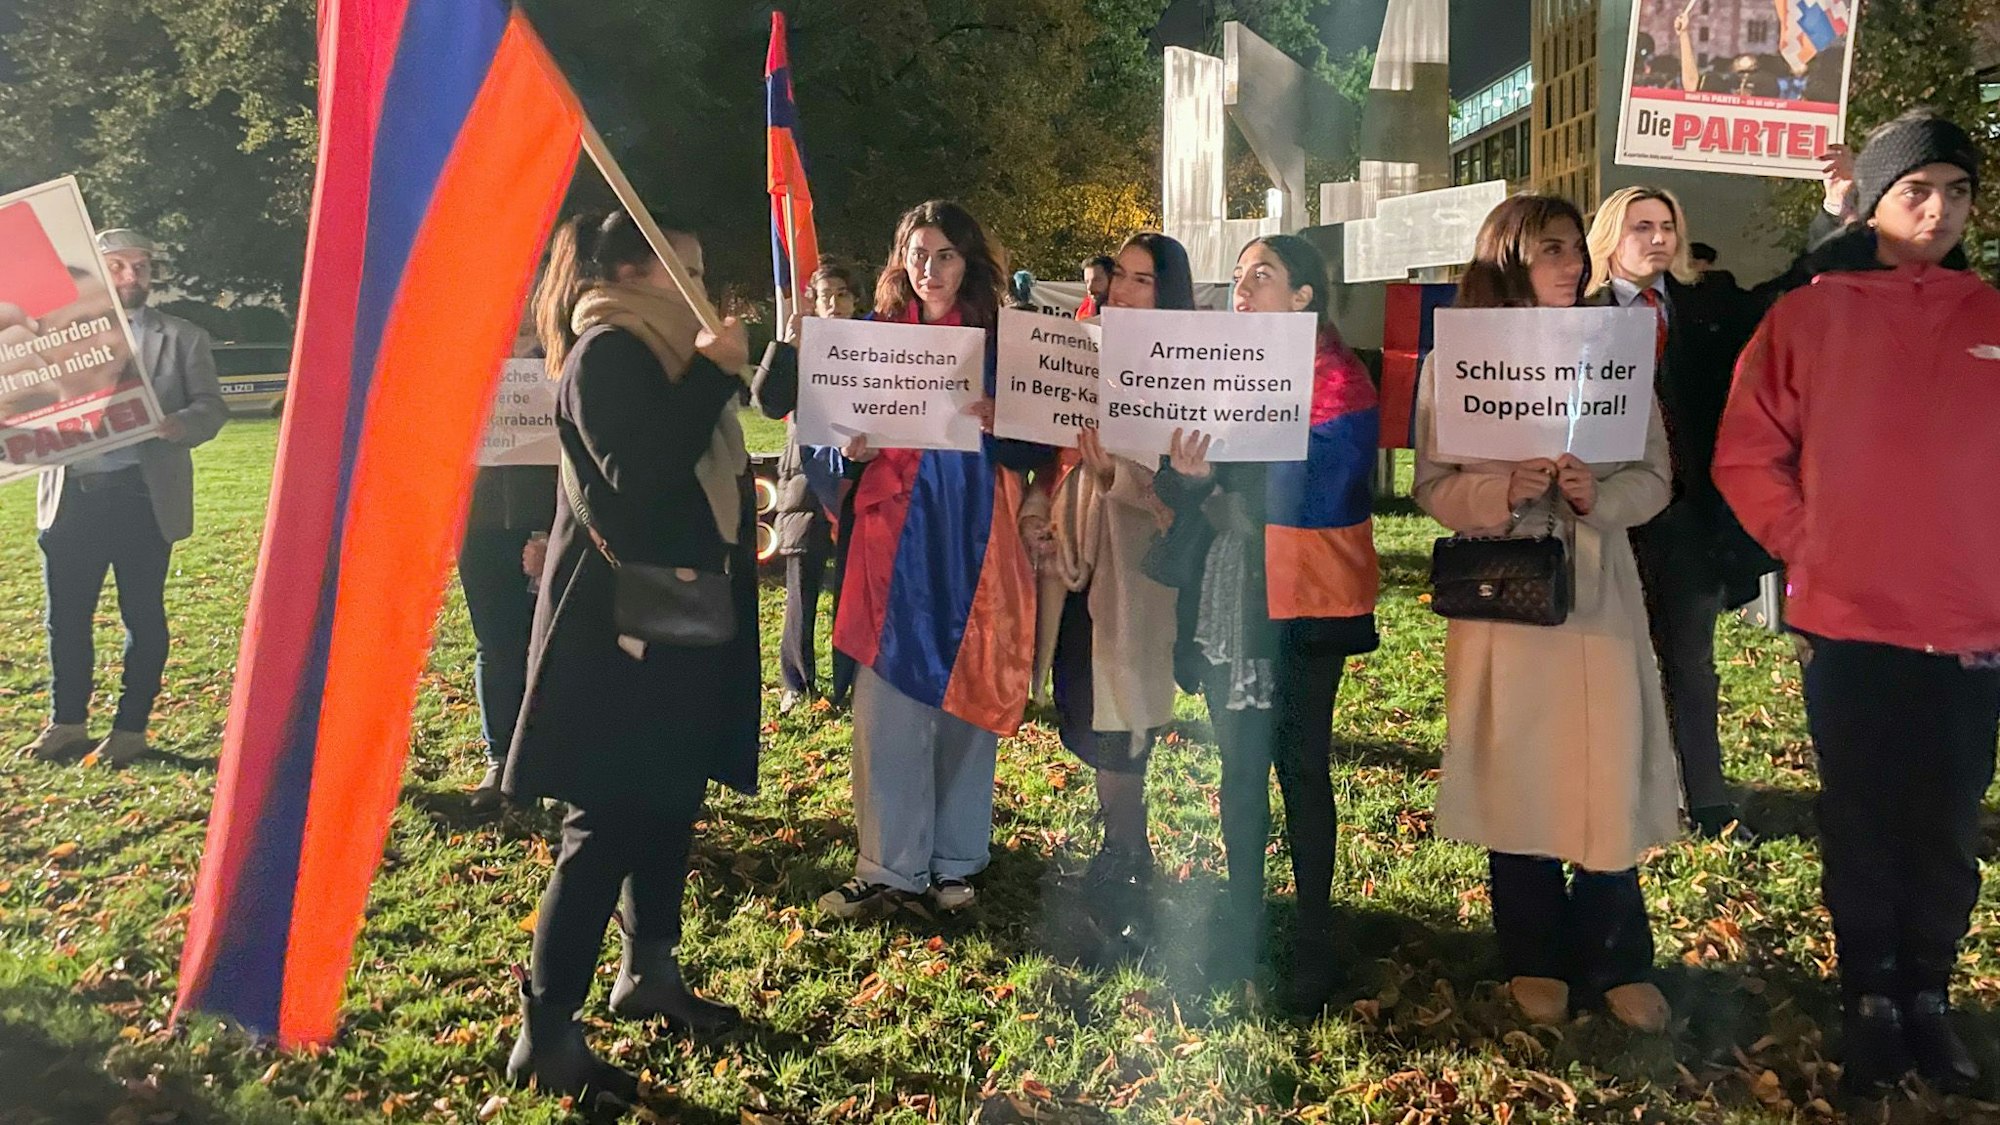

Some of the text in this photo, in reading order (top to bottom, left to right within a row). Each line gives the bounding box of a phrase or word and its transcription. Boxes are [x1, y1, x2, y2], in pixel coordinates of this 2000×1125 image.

[1637, 109, 1829, 159] Die PARTEI
[1031, 327, 1098, 353] Armenis
[1150, 341, 1264, 362] Armeniens
[22, 363, 62, 387] man
[65, 344, 114, 373] nicht
[827, 345, 957, 365] Aserbaidschan
[1039, 354, 1099, 379] Kulture
[1120, 370, 1291, 392] Grenzen müssen
[1456, 359, 1636, 381] Schluss mit der
[812, 373, 970, 391] muss sanktioniert
[1011, 376, 1098, 404] in Berg-Ka
[853, 400, 926, 416] werden!
[1109, 399, 1299, 422] geschützt werden!
[1464, 395, 1627, 420] Doppelmoral!
